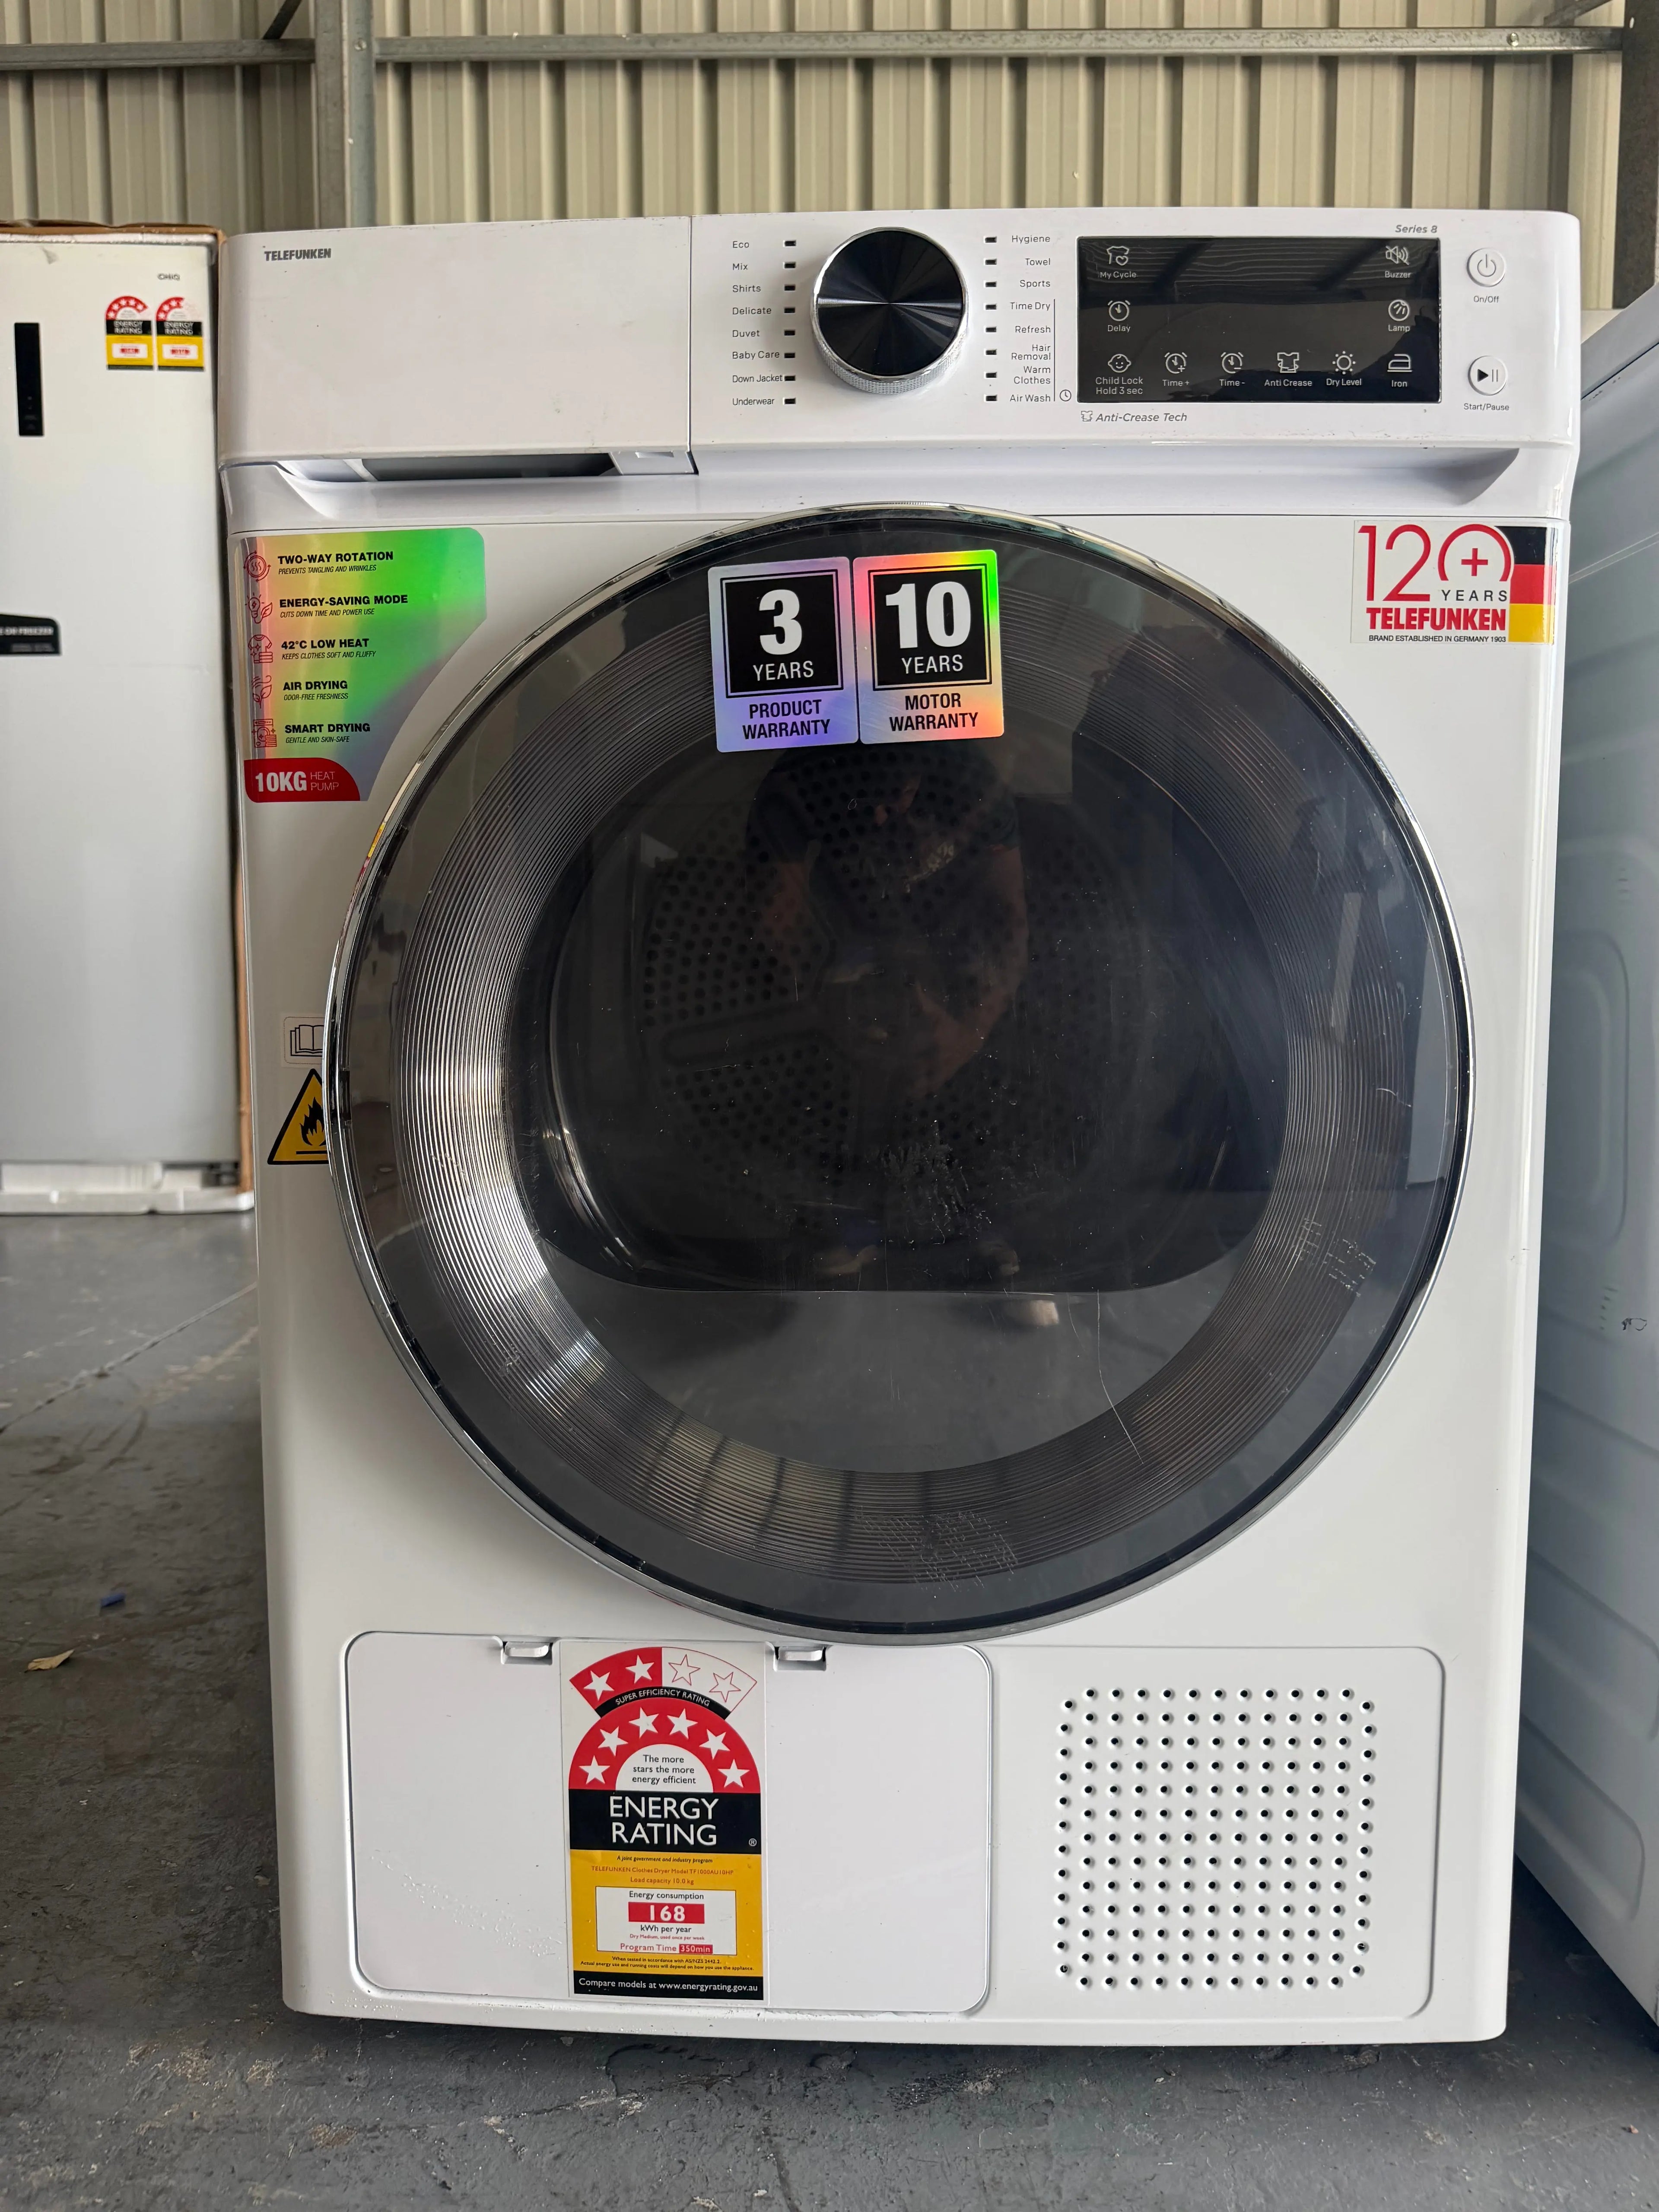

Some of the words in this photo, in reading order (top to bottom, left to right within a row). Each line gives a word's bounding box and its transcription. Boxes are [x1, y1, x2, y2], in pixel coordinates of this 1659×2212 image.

[1395, 224, 1426, 233] Series
[1431, 225, 1437, 233] 8
[732, 240, 749, 248] Eco
[1012, 235, 1050, 244] Hygiene
[264, 248, 331, 261] TELEFUNKEN
[732, 262, 748, 270] Mix
[1117, 270, 1136, 279] Cycle
[1020, 280, 1050, 289] Sports
[1473, 295, 1499, 304] On/Off
[732, 307, 772, 315] Delicate
[1035, 302, 1050, 312] Dry
[732, 329, 760, 337] Duvet
[1108, 325, 1130, 333] Delay
[1388, 325, 1410, 333] Lamp
[732, 351, 756, 360] Baby
[758, 350, 779, 359] Care
[756, 374, 782, 383] Jacket
[1326, 378, 1339, 387] Dry
[1464, 403, 1509, 412] Start/Pause
[1096, 413, 1159, 422] Anti-Crease
[1164, 413, 1187, 422] Tech
[278, 554, 332, 564] TWO-WAY
[336, 551, 393, 562] ROTATION
[1441, 590, 1507, 601] YEARS
[280, 596, 370, 607] ENERGY-SAVING
[374, 595, 408, 604] MODE
[886, 581, 971, 649] 10
[1366, 607, 1506, 630] TELEFUNKEN
[760, 589, 802, 655] 3
[281, 640, 307, 649] 42°C
[311, 639, 336, 648] LOW
[340, 639, 369, 648] HEAT
[902, 655, 963, 674] YEARS
[753, 661, 814, 681] YEARS
[283, 682, 302, 690] AIR
[305, 680, 348, 690] DRYING
[905, 693, 961, 710] MOTOR
[750, 699, 822, 718] PRODUCT
[890, 712, 978, 731] WARRANTY
[285, 724, 324, 733] SMART
[327, 723, 370, 732] DRYING
[743, 719, 830, 739] WARRANTY
[310, 772, 336, 780] HEAT
[255, 771, 307, 792] 10KG
[311, 782, 339, 791] PUMP
[616, 1692, 637, 1705] SUPER
[639, 1689, 680, 1697] EFFICIENCY
[682, 1691, 710, 1707] RATING
[610, 1796, 718, 1819] ENERGY
[612, 1822, 717, 1845] RATING
[629, 1891, 654, 1900] Energy
[657, 1892, 704, 1901] consumption
[650, 1906, 685, 1921] 168
[620, 1943, 654, 1952] Program
[579, 1978, 616, 1988] Compare
[659, 1983, 758, 1993] www.energyrating.gov.au
